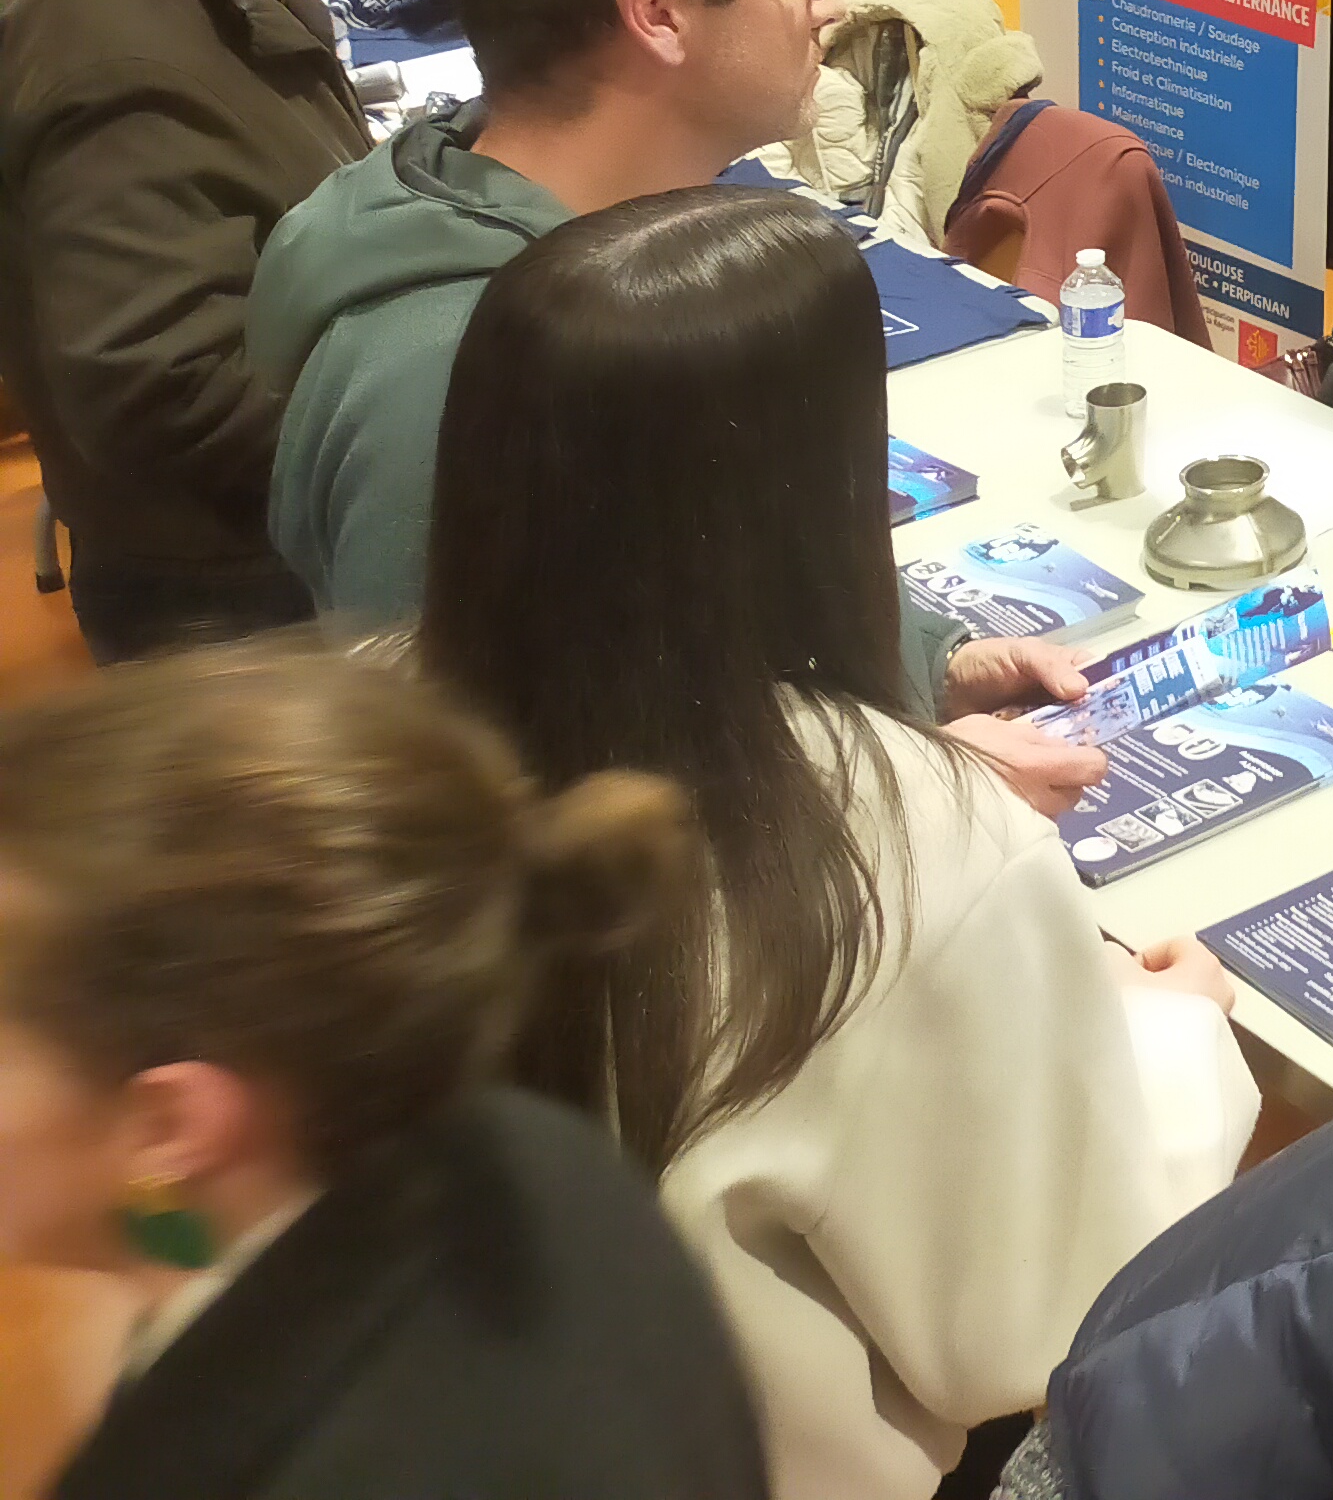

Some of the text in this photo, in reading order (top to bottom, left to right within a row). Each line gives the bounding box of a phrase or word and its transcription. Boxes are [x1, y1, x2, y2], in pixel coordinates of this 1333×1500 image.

[1112, 17, 1244, 71] Conception industrielle
[1208, 24, 1261, 54] Soudage
[1112, 38, 1208, 82] Electrotechnique
[1112, 61, 1232, 113] Froid et Climatisation
[1112, 82, 1184, 118] Informatique
[1112, 104, 1184, 140] Maintenance
[1159, 167, 1249, 210] tion industrielle
[1186, 152, 1260, 190] Electronique
[1186, 248, 1244, 283] TOULOUSE
[1190, 269, 1209, 288] AC
[1221, 281, 1290, 319] PERPIGNAN
